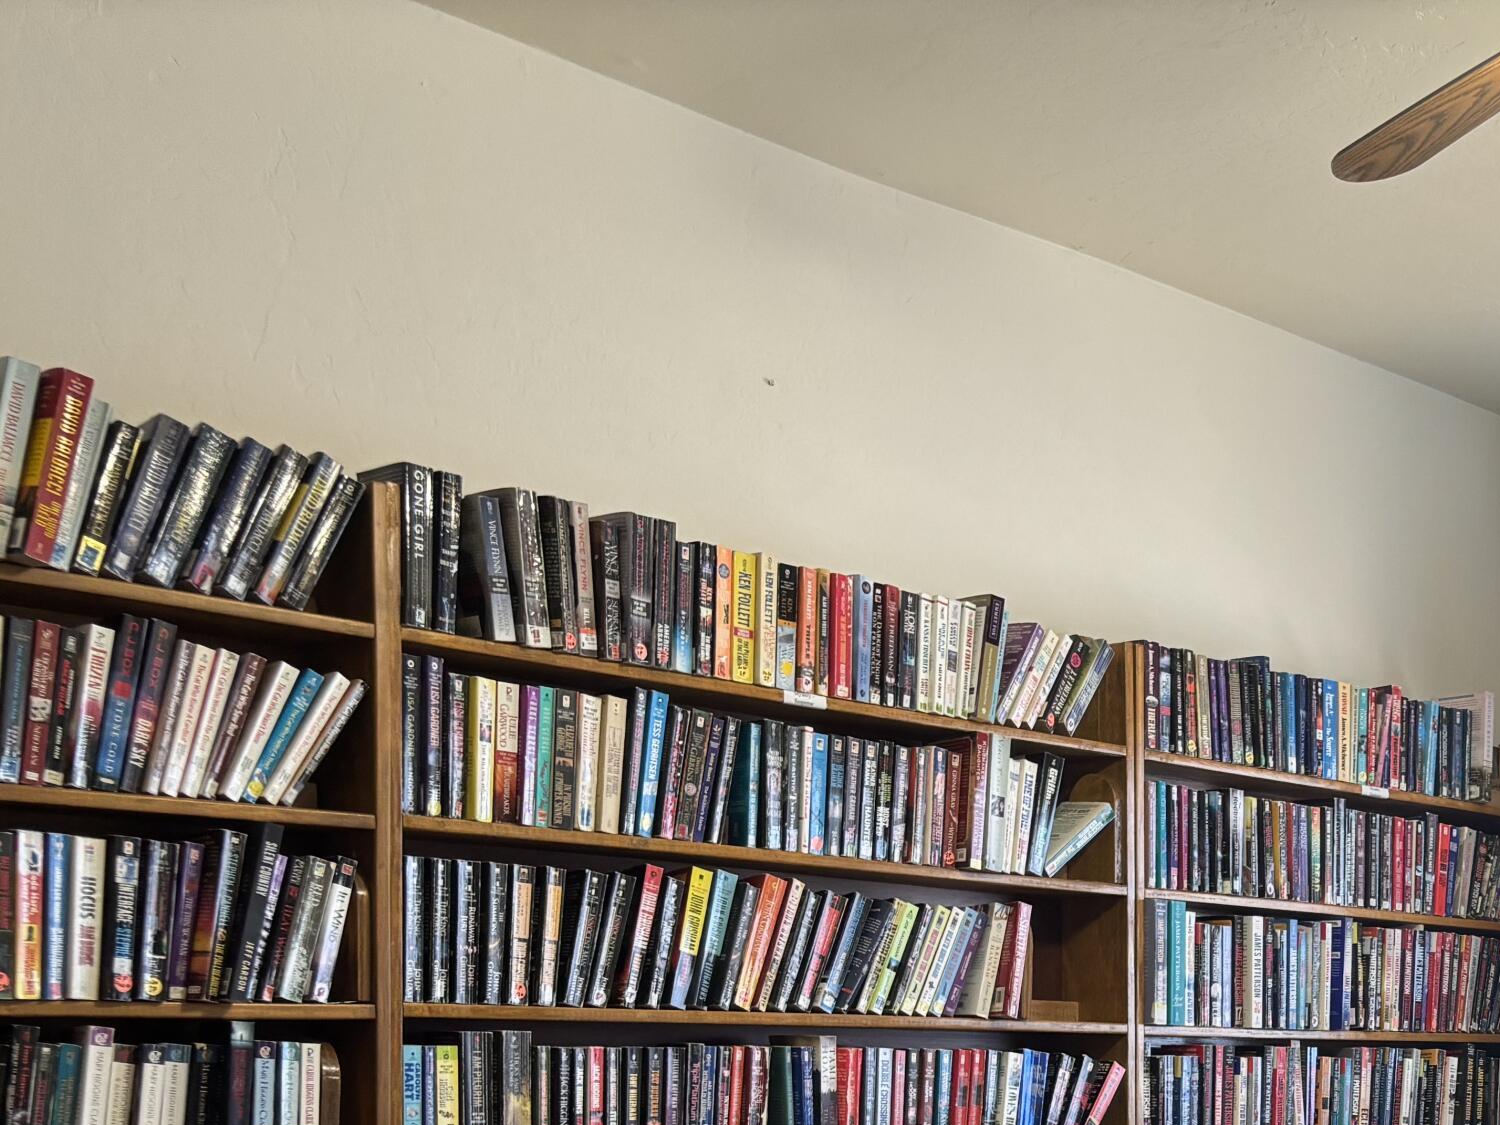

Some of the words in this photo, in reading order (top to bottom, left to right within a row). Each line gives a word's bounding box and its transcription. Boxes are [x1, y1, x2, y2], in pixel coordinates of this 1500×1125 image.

[61, 396, 82, 434] DAVID
[46, 438, 74, 497] BALDACCI
[145, 454, 171, 485] DAVID
[129, 486, 162, 531] BALDACCI
[413, 470, 426, 515] GONE
[414, 523, 426, 560] GIRL
[488, 520, 498, 546] VINCE
[578, 522, 586, 555] VINCE
[491, 547, 502, 574] FLYNN
[580, 559, 589, 591] FLYNN
[738, 572, 751, 589] KEN
[763, 572, 774, 585] KEN
[736, 591, 753, 627] FOLLETT
[763, 586, 774, 624] FOLLETT
[431, 687, 440, 704] LISA
[112, 701, 126, 735] STONE
[135, 719, 152, 743] DARK
[430, 707, 440, 746] GARDNER
[500, 704, 509, 748] GARWOOD
[509, 714, 519, 739] JULIE
[653, 720, 661, 736] TESS
[105, 741, 118, 773] COLD
[129, 745, 149, 767] SKY
[648, 738, 660, 779] GERRITSEN
[862, 807, 872, 848] HAUNTED
[259, 841, 279, 864] SILENT
[255, 865, 272, 897] COUNTRY
[80, 877, 96, 918] HOCUS
[117, 884, 136, 923] INTERFACE
[643, 890, 655, 910] JOHN
[690, 894, 704, 913] JOHN
[468, 907, 476, 942] RUNAWAY
[633, 911, 654, 949] GRISHAM
[684, 915, 699, 951] GRISHAM
[244, 941, 255, 960] JEFF
[237, 961, 252, 992] CARSON
[1253, 959, 1261, 998] PATTERSON
[305, 1064, 315, 1083] CAROL
[474, 1055, 482, 1067] AM
[691, 1062, 699, 1082] Triple
[305, 1084, 314, 1106] HIGGINS
[405, 1063, 415, 1100] HART
[473, 1069, 482, 1106] PILGRIM
[560, 1075, 569, 1097] JACK
[305, 1107, 313, 1125] CLARK
[690, 1084, 698, 1120] Platinum
